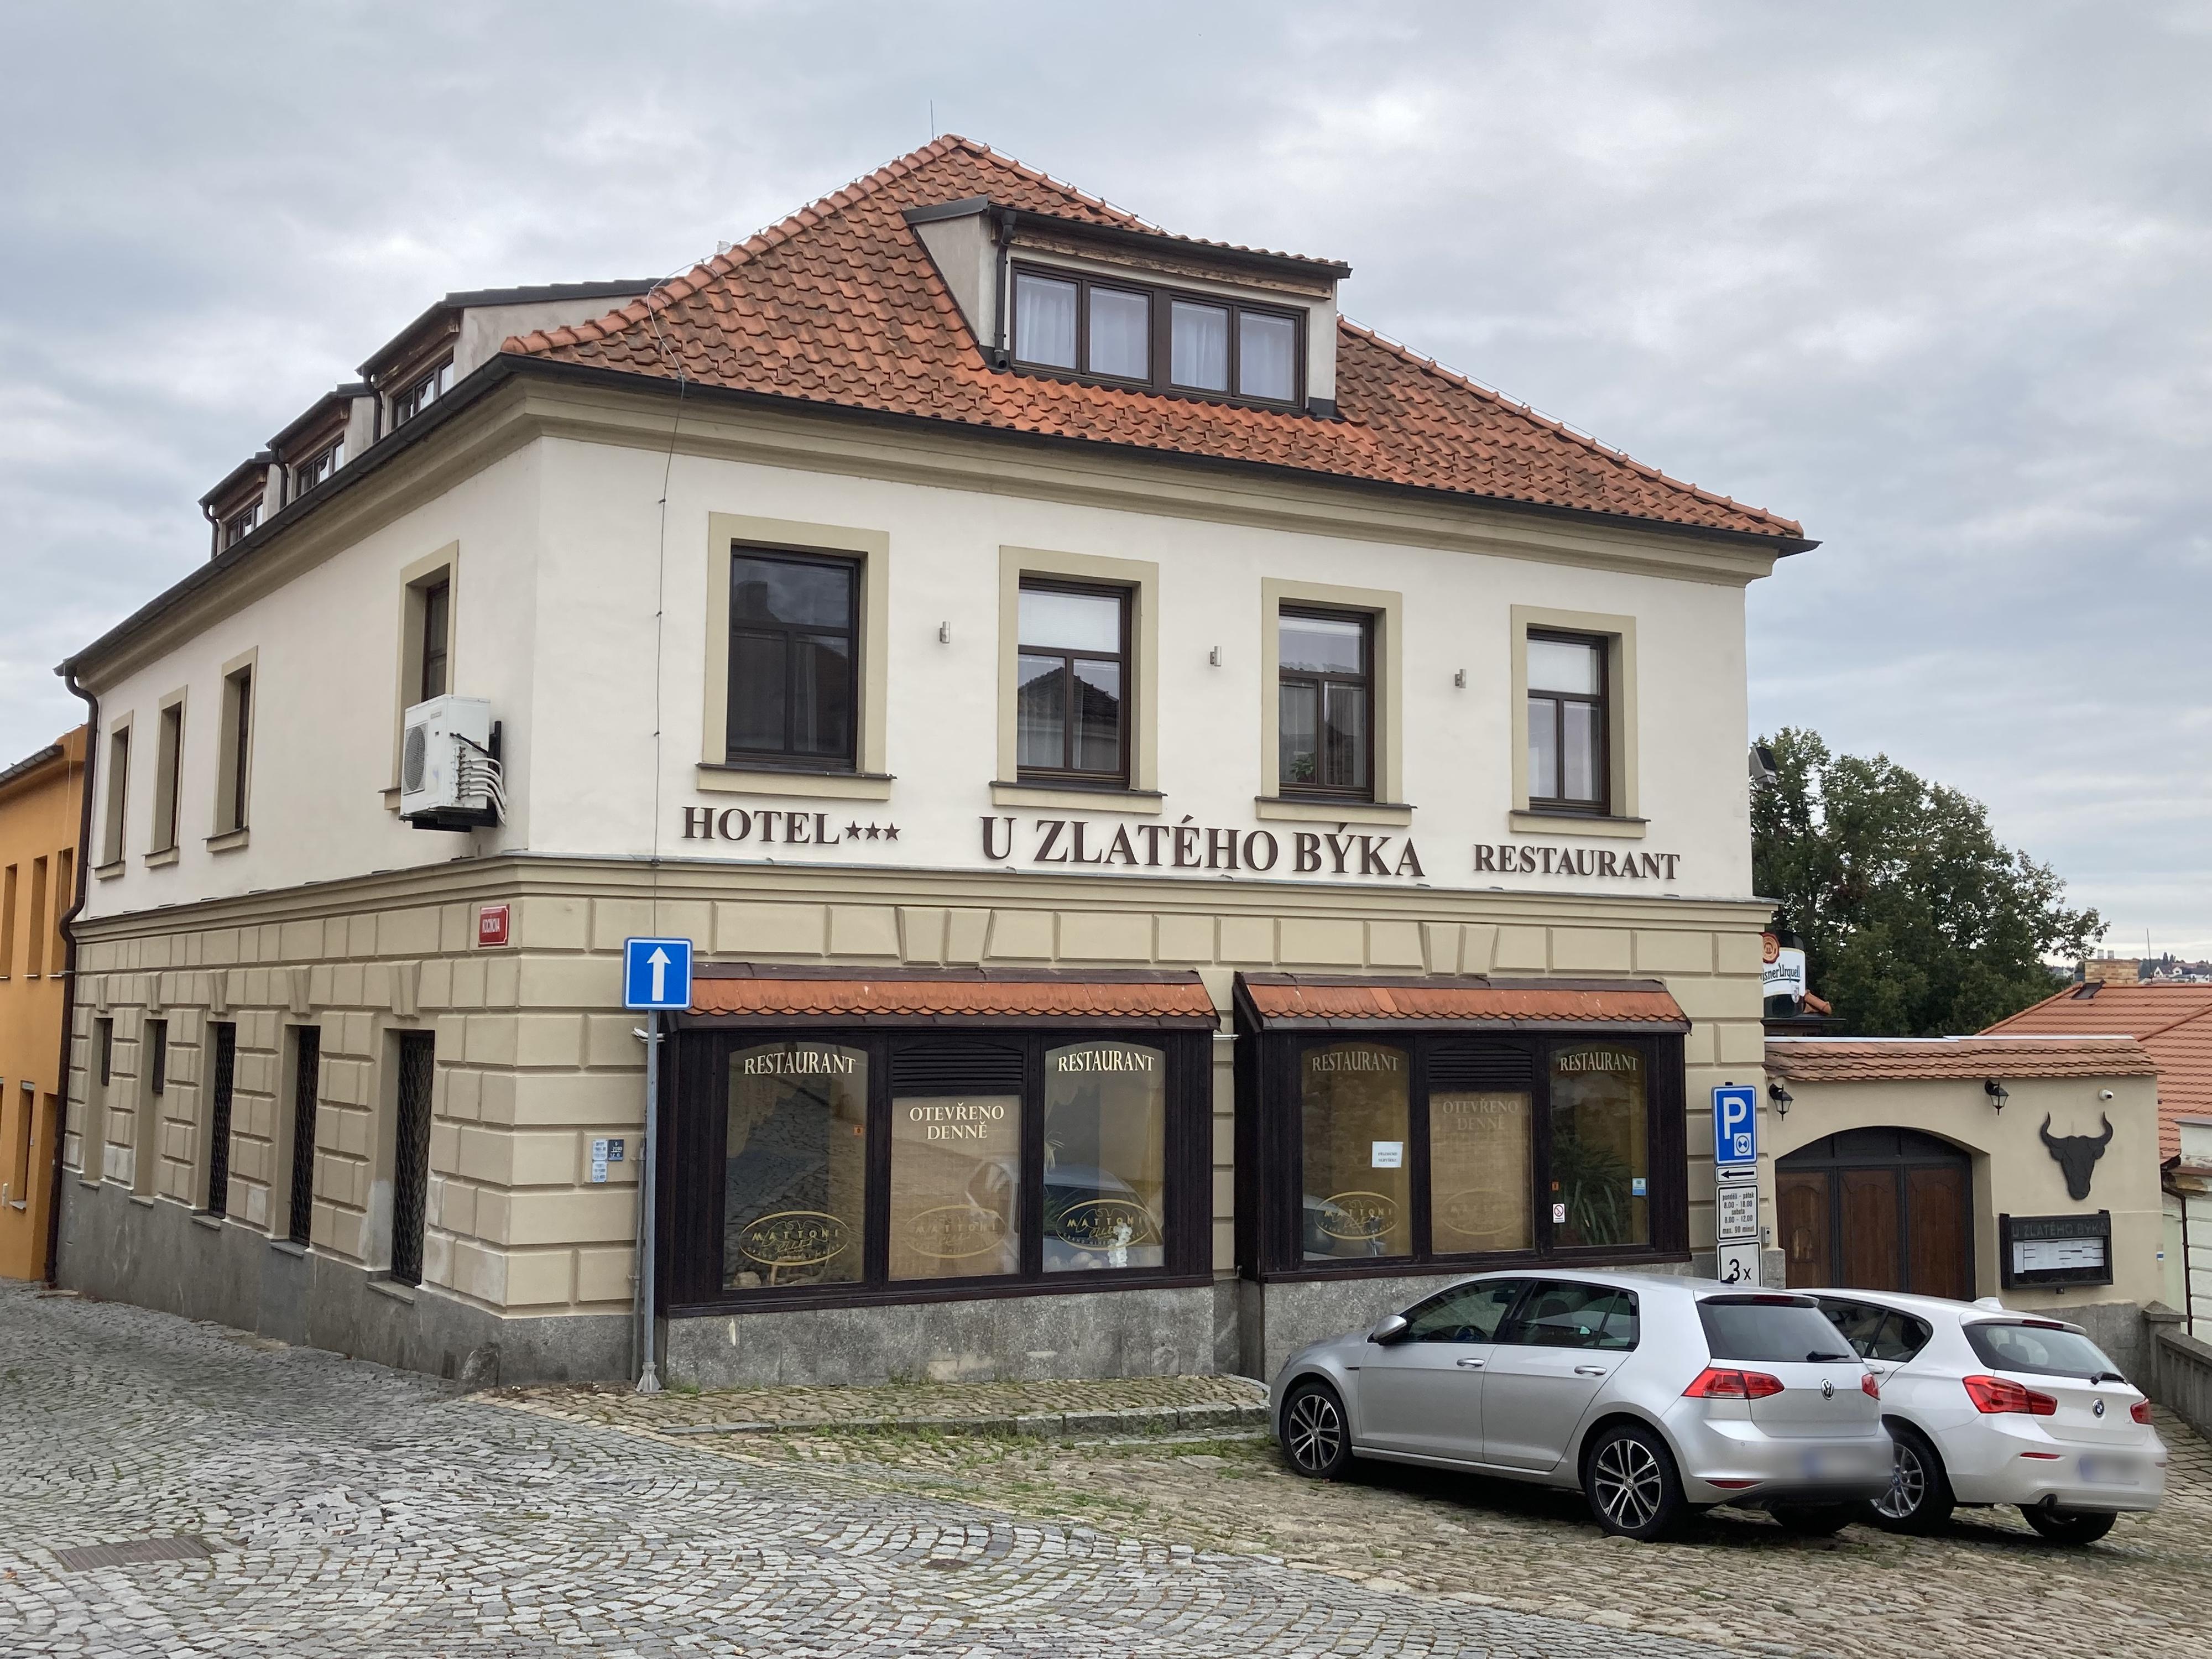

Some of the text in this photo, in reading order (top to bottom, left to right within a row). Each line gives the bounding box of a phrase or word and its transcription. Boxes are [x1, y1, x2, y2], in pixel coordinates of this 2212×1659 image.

[681, 806, 840, 845] HOTEL
[979, 813, 1426, 877] U ZLATÉHO BÝKA
[1474, 843, 1681, 880] RESTAURANT
[1778, 962, 1801, 983] Urquell
[744, 1051, 856, 1074] RESTAURANT
[1058, 1050, 1155, 1071] RESTAURANT
[1312, 1051, 1399, 1071] RESTAURANT
[1560, 1051, 1638, 1071] RESTAURANT
[909, 1102, 1004, 1121] OTEVŘENO
[1442, 1097, 1519, 1114] OTEVŘENO
[1457, 1114, 1505, 1130] DENNĚ
[1723, 1097, 1746, 1140] P
[927, 1120, 988, 1140] DENNĚ
[1067, 1216, 1142, 1227] MATTONI
[752, 1229, 838, 1241] MATTONI
